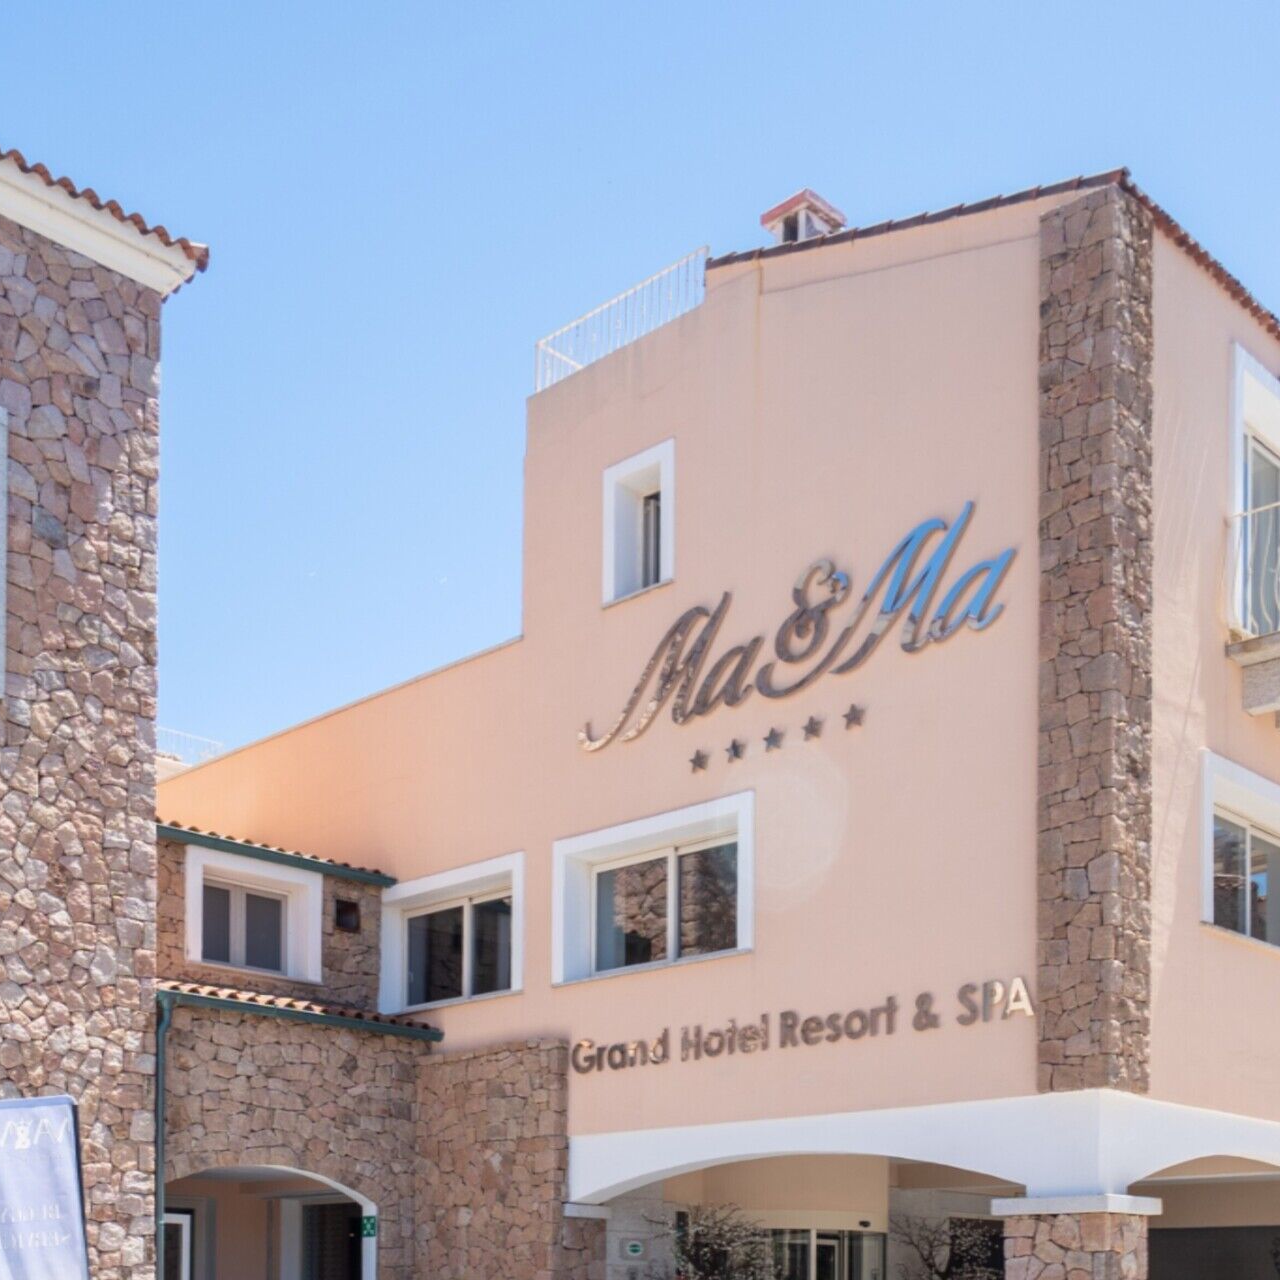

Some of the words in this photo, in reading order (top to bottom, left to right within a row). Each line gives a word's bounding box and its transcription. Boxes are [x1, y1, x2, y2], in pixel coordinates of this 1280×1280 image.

[577, 500, 1018, 753] Ma&Ma
[570, 1026, 670, 1075] Grand
[680, 1013, 770, 1062] Hotel
[779, 995, 899, 1050] Resort
[912, 992, 940, 1033] &
[956, 976, 1035, 1027] SPA
